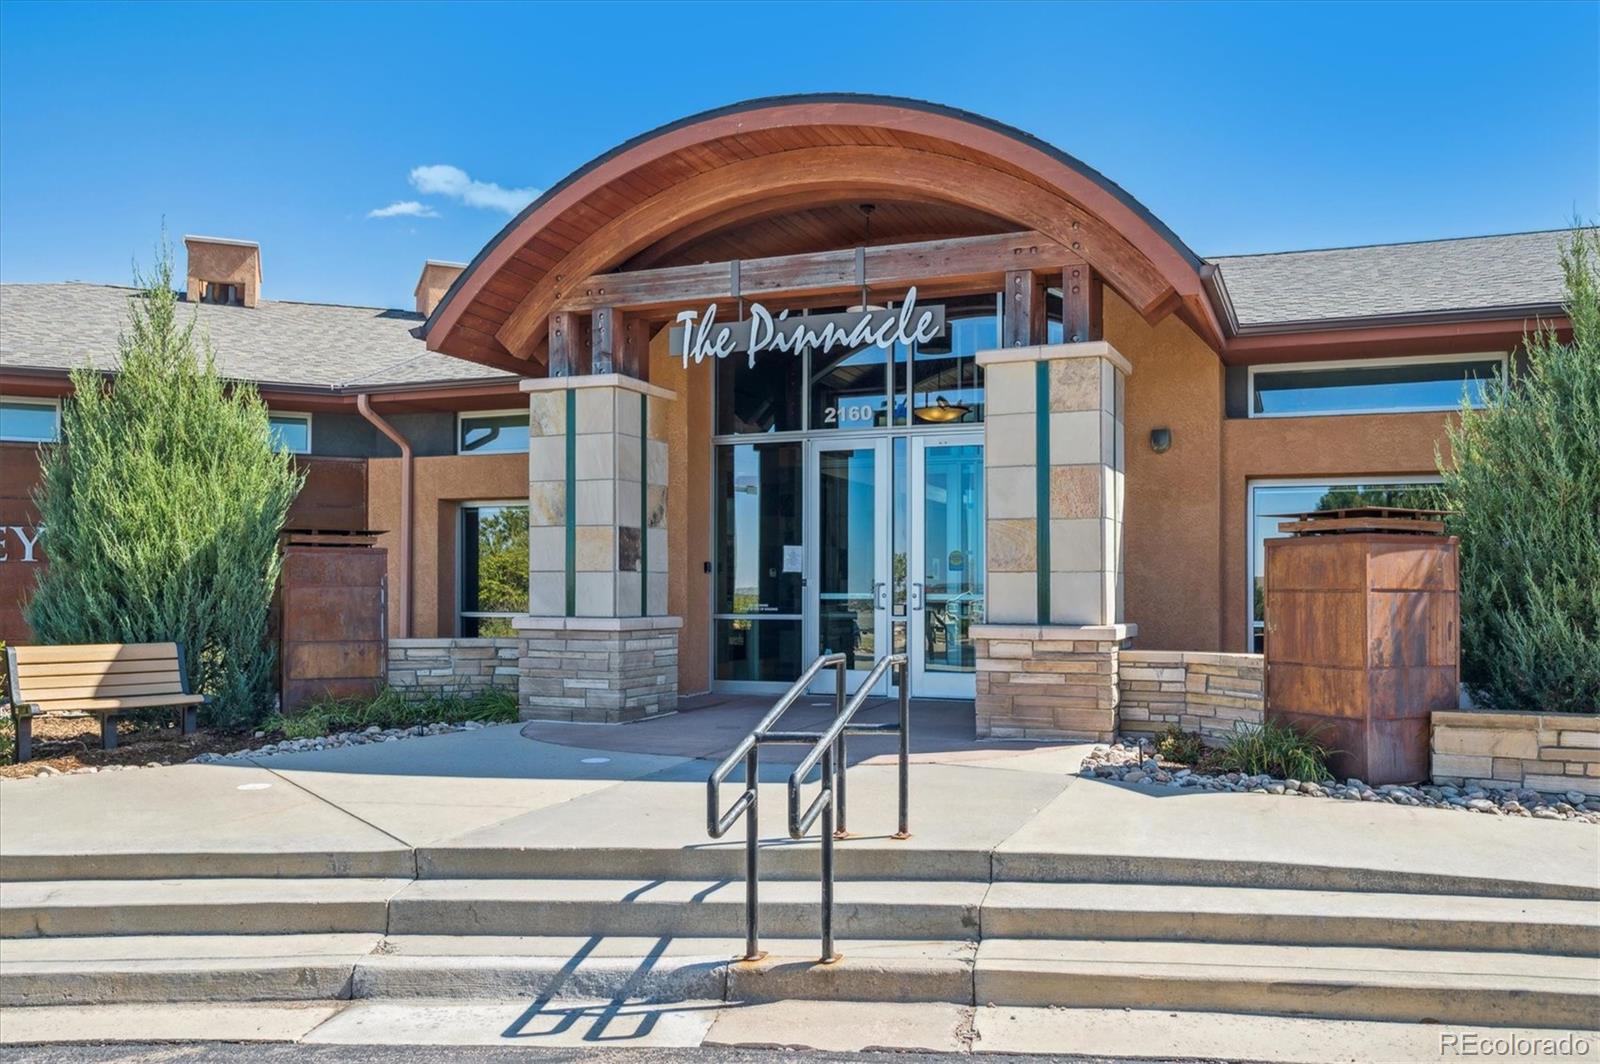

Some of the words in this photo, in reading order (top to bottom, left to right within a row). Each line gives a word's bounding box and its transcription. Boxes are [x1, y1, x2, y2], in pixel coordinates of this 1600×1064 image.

[676, 303, 736, 369] The
[748, 286, 940, 369] Pinnacle
[824, 405, 872, 423] 2160
